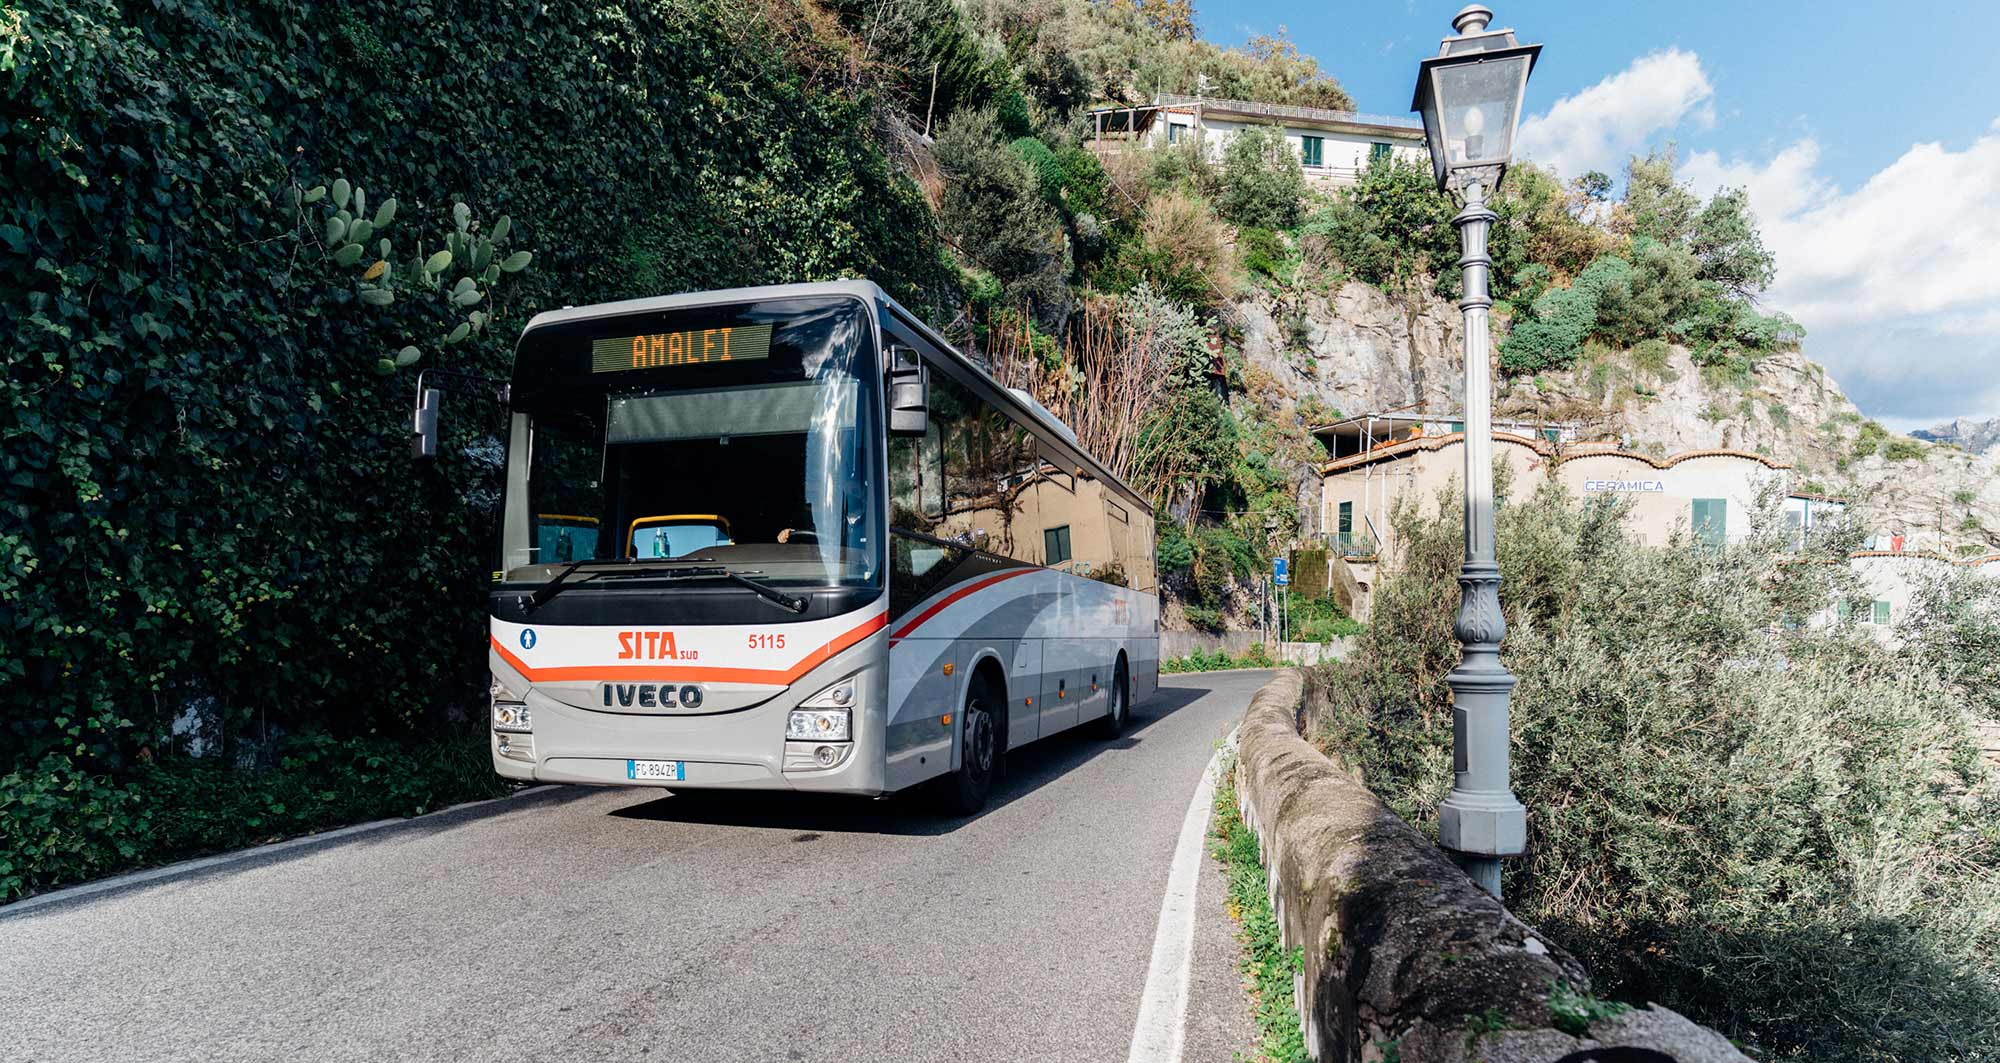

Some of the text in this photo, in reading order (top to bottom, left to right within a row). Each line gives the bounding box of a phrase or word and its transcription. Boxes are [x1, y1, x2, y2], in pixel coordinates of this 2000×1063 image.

[632, 327, 733, 368] AMALFI
[1585, 480, 1664, 491] CERAMICA
[618, 631, 698, 660] SITA SUD
[748, 634, 785, 649] 5115
[603, 683, 703, 708] IVECO
